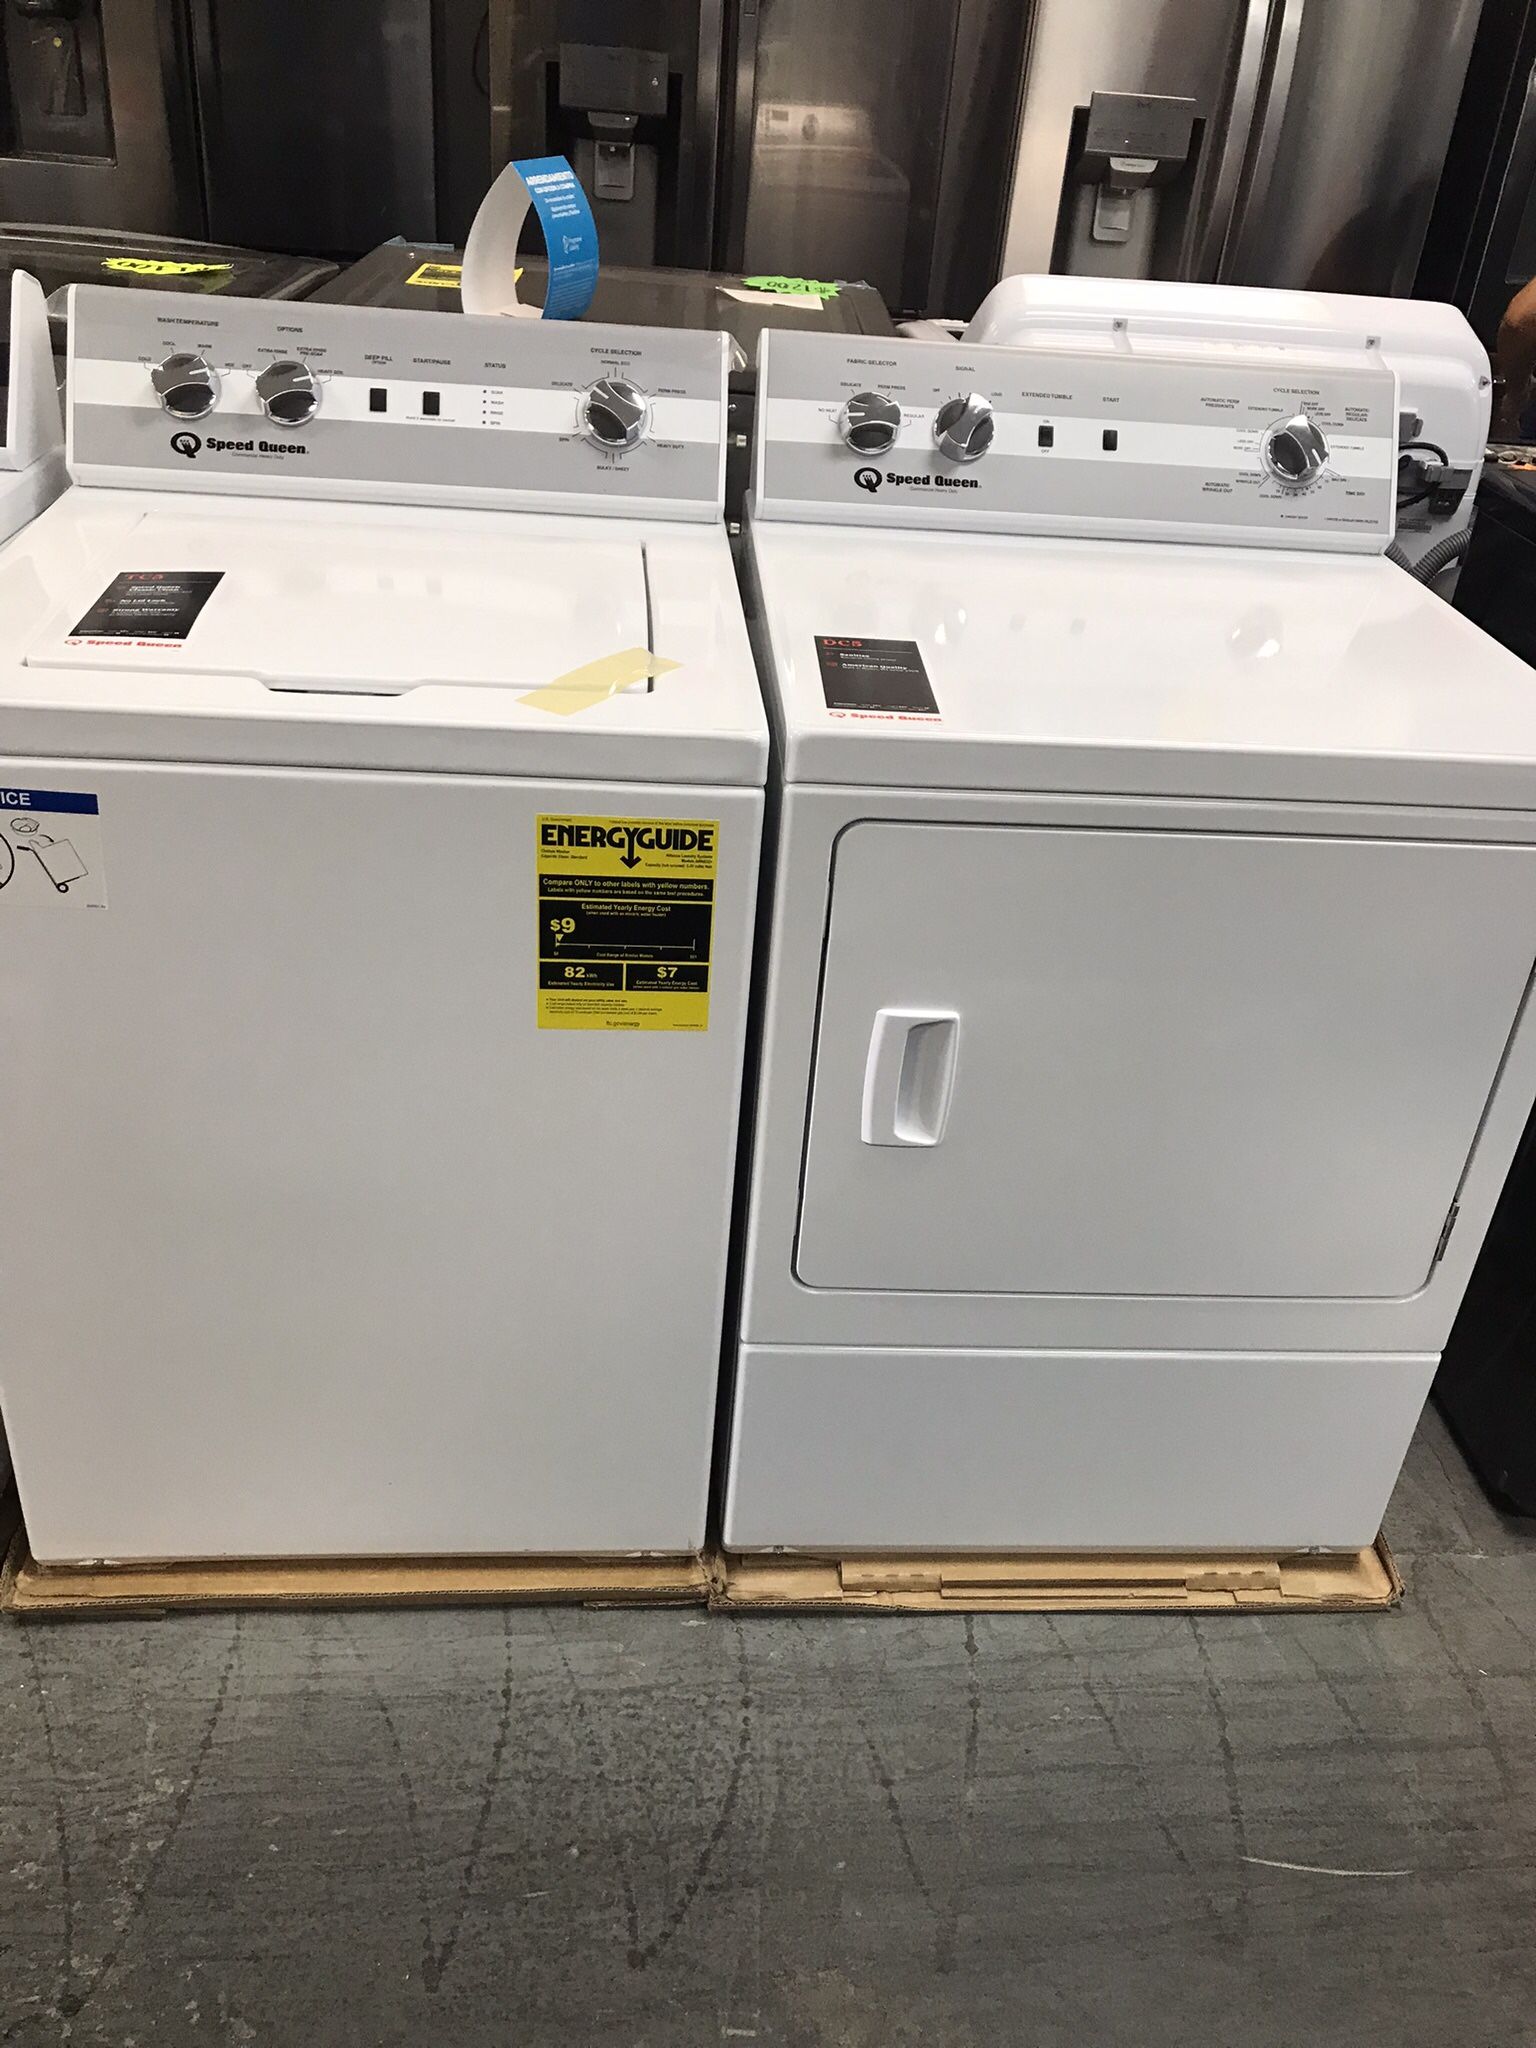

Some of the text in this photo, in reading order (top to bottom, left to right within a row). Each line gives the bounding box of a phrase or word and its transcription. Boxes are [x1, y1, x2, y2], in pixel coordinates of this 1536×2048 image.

[176, 318, 219, 327] TEMPERATURE
[413, 357, 451, 366] START/PAUSE
[1021, 391, 1051, 399] EXTENDED
[206, 437, 306, 454] Speed Queen
[886, 472, 978, 488] Speed Queen
[0, 791, 31, 805] ICE
[541, 824, 714, 852] ENERGYGUIDE
[543, 878, 573, 887] Compare
[574, 879, 593, 887] ONLY
[657, 882, 678, 890] yellow
[550, 917, 576, 933] $9
[564, 966, 586, 978] 82
[657, 966, 678, 978] $7
